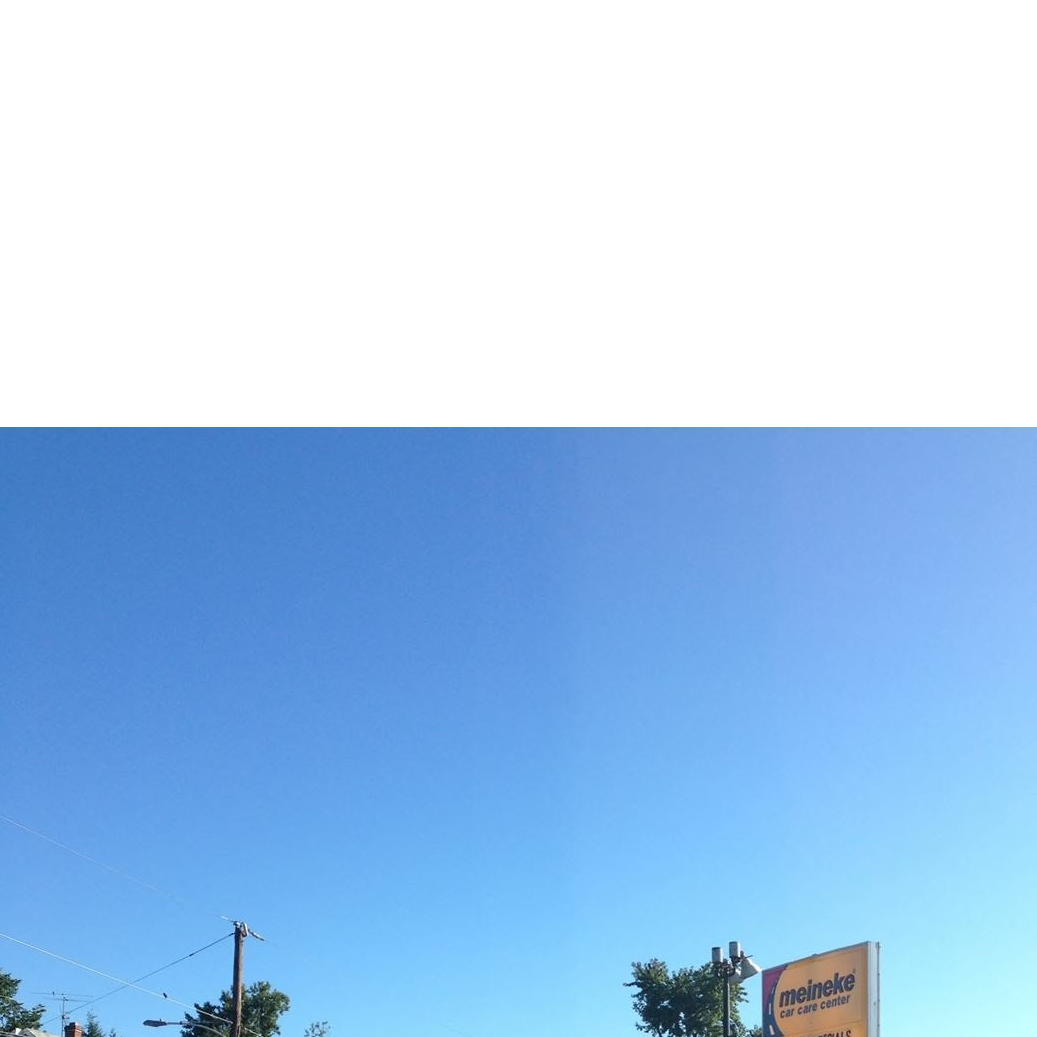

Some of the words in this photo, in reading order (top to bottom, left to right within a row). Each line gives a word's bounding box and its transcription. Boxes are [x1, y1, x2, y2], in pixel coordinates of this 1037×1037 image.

[779, 972, 855, 1008] meineke
[780, 1008, 795, 1018] car
[797, 1002, 818, 1015] care
[820, 994, 851, 1010] center
